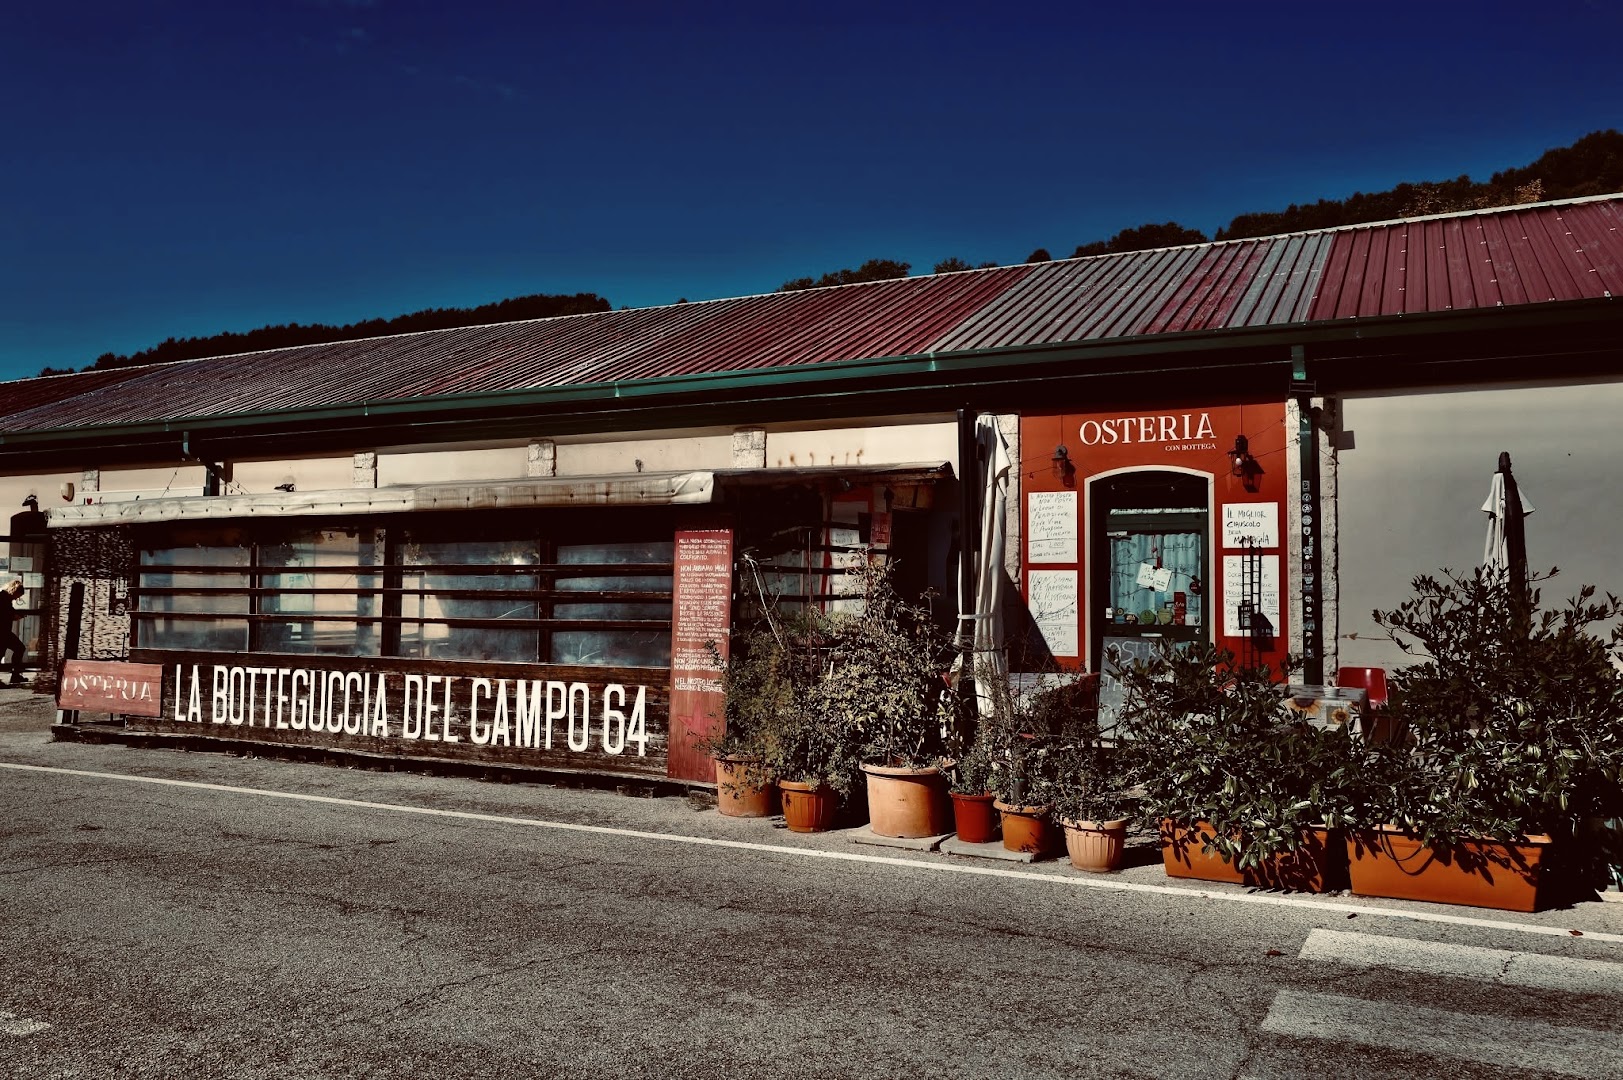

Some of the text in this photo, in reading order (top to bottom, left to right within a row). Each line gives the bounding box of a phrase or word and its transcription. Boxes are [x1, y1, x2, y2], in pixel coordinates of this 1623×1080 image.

[1079, 413, 1216, 446] OSTERIA
[1182, 443, 1216, 451] BOTTEGA
[1238, 510, 1267, 520] MIGLIOR
[63, 675, 152, 702] OSTERIA
[174, 663, 650, 756] LA BOTTEGUCCIA DEL CAMPO 64
